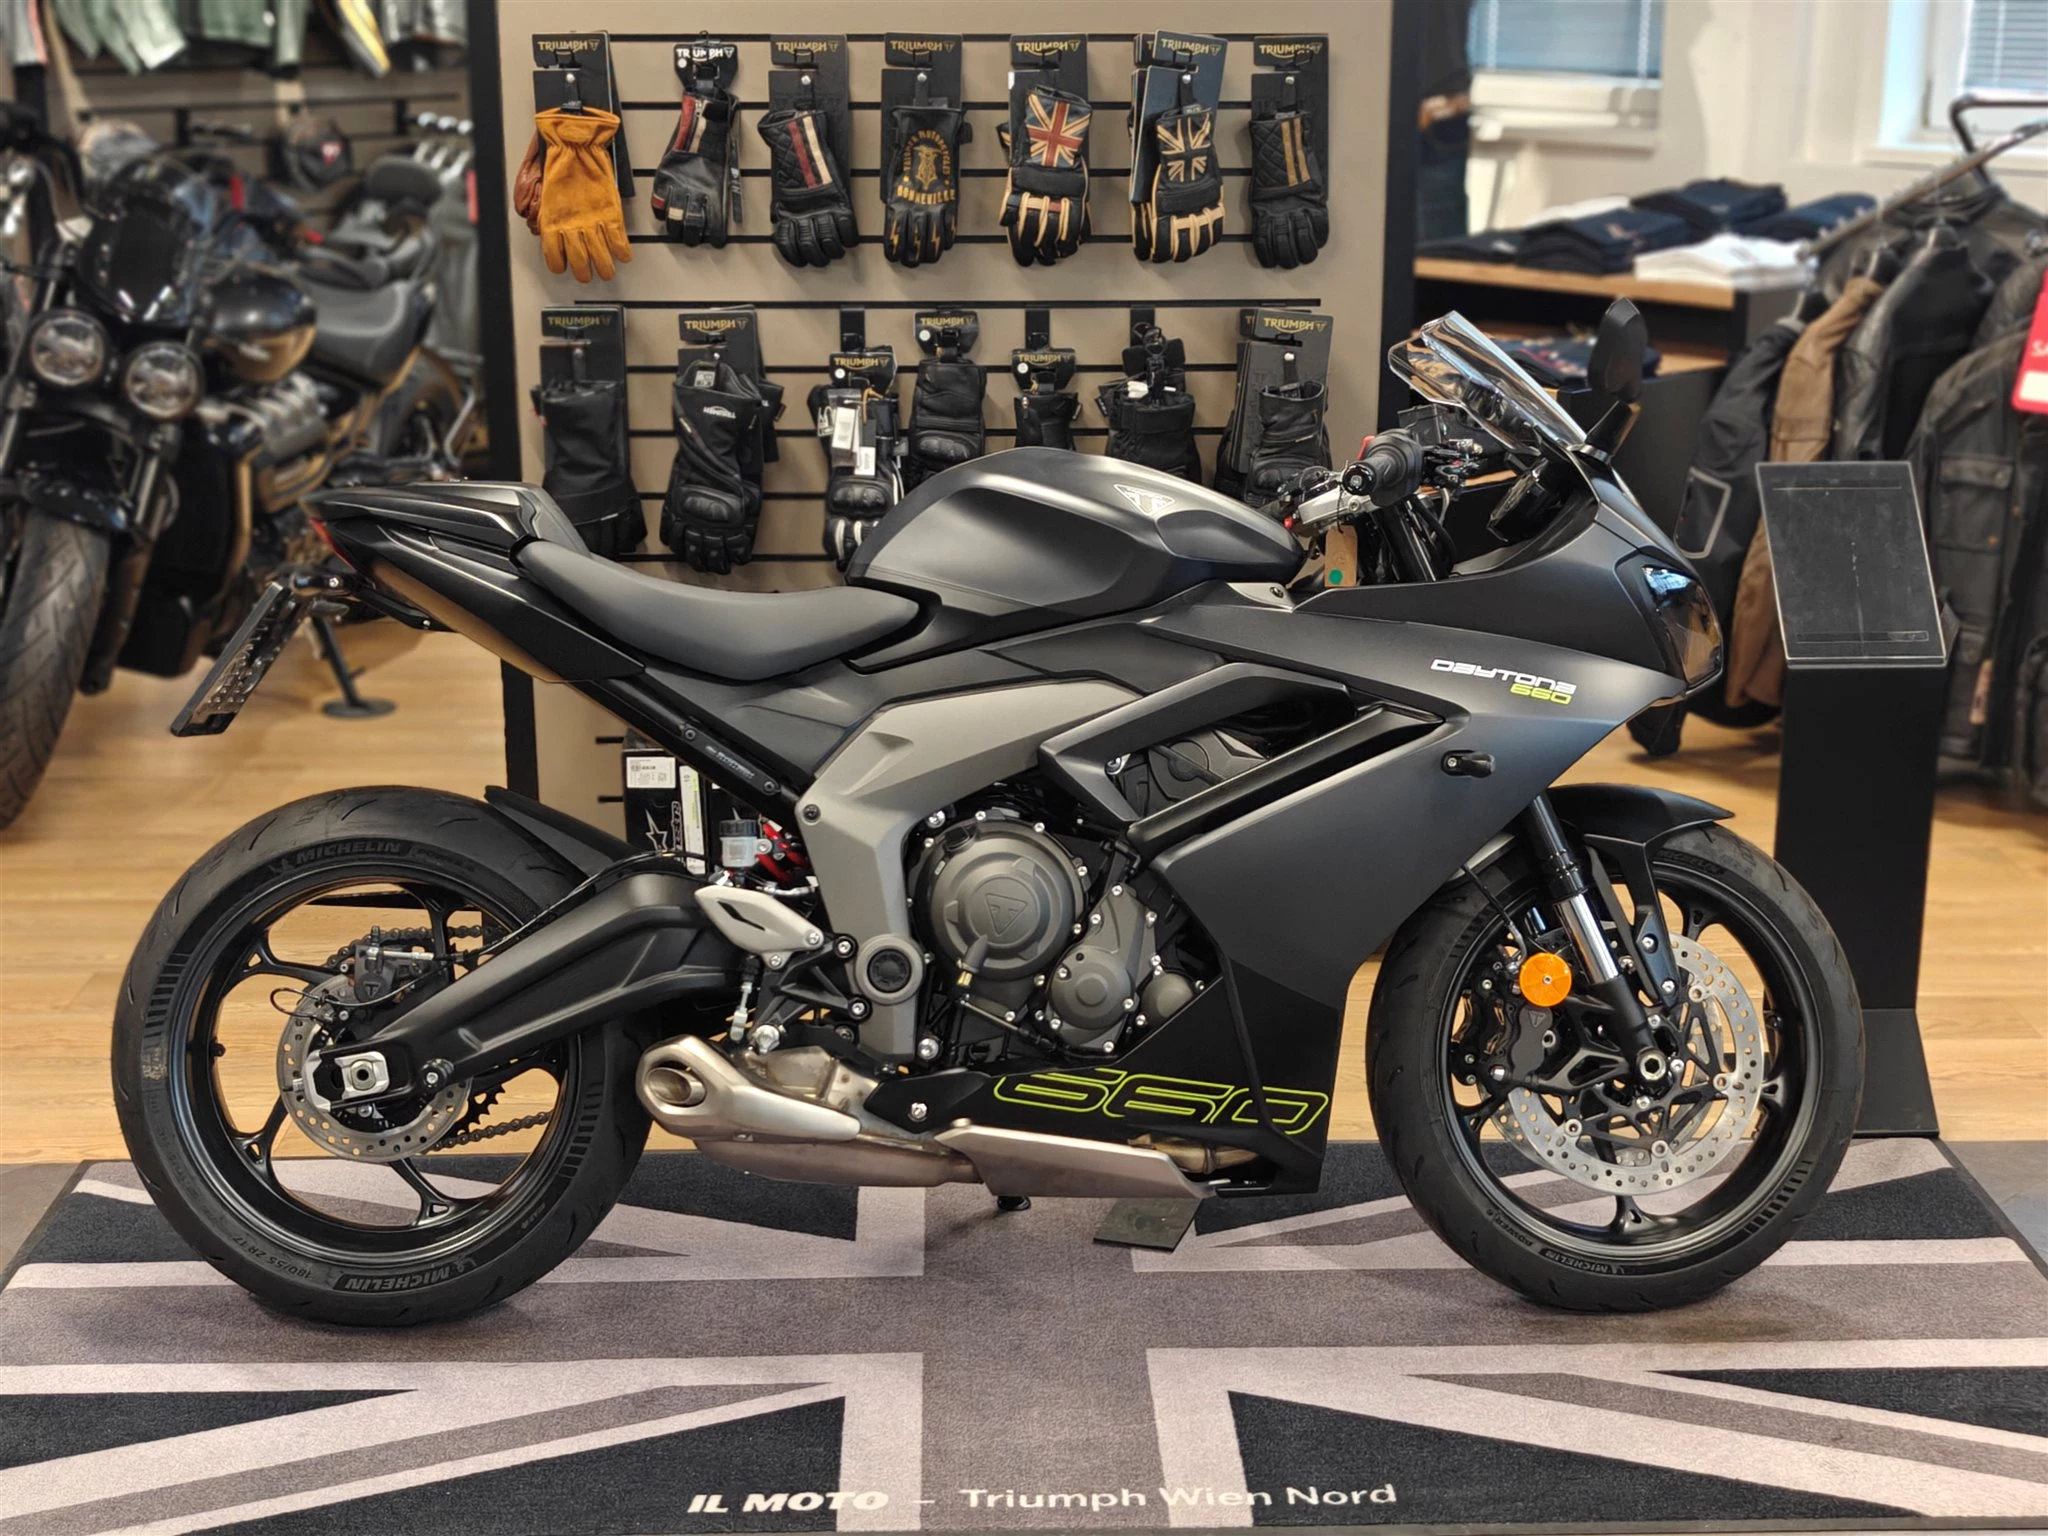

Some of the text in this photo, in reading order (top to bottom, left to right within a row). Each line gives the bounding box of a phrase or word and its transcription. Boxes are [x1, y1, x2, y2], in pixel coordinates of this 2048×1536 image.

[537, 40, 588, 54] TRIUMPH
[776, 41, 827, 55] TRIUMPH
[891, 40, 942, 54] TRIUMPH
[1016, 41, 1069, 55] TRIUMPH
[1161, 38, 1209, 55] TRIUMPH
[547, 316, 600, 329] TRIUMPH
[684, 319, 736, 334] TRIUMPH
[920, 317, 965, 328] TRIUMPH
[1263, 317, 1315, 334] TRIUMPH
[834, 357, 879, 370] TRIUMPH
[1018, 353, 1062, 366] TRIUMPH
[1510, 683, 1572, 705] 660
[297, 841, 401, 863] MICHELIN
[993, 1067, 1329, 1134] 660
[1544, 1250, 1609, 1273] MICHELIN
[344, 1265, 451, 1291] MICHELIN
[687, 1494, 729, 1514] IL
[742, 1491, 889, 1512] MOTO
[958, 1488, 1147, 1512] Triumph
[1158, 1487, 1273, 1507] Wien
[1285, 1483, 1398, 1506] Nord
